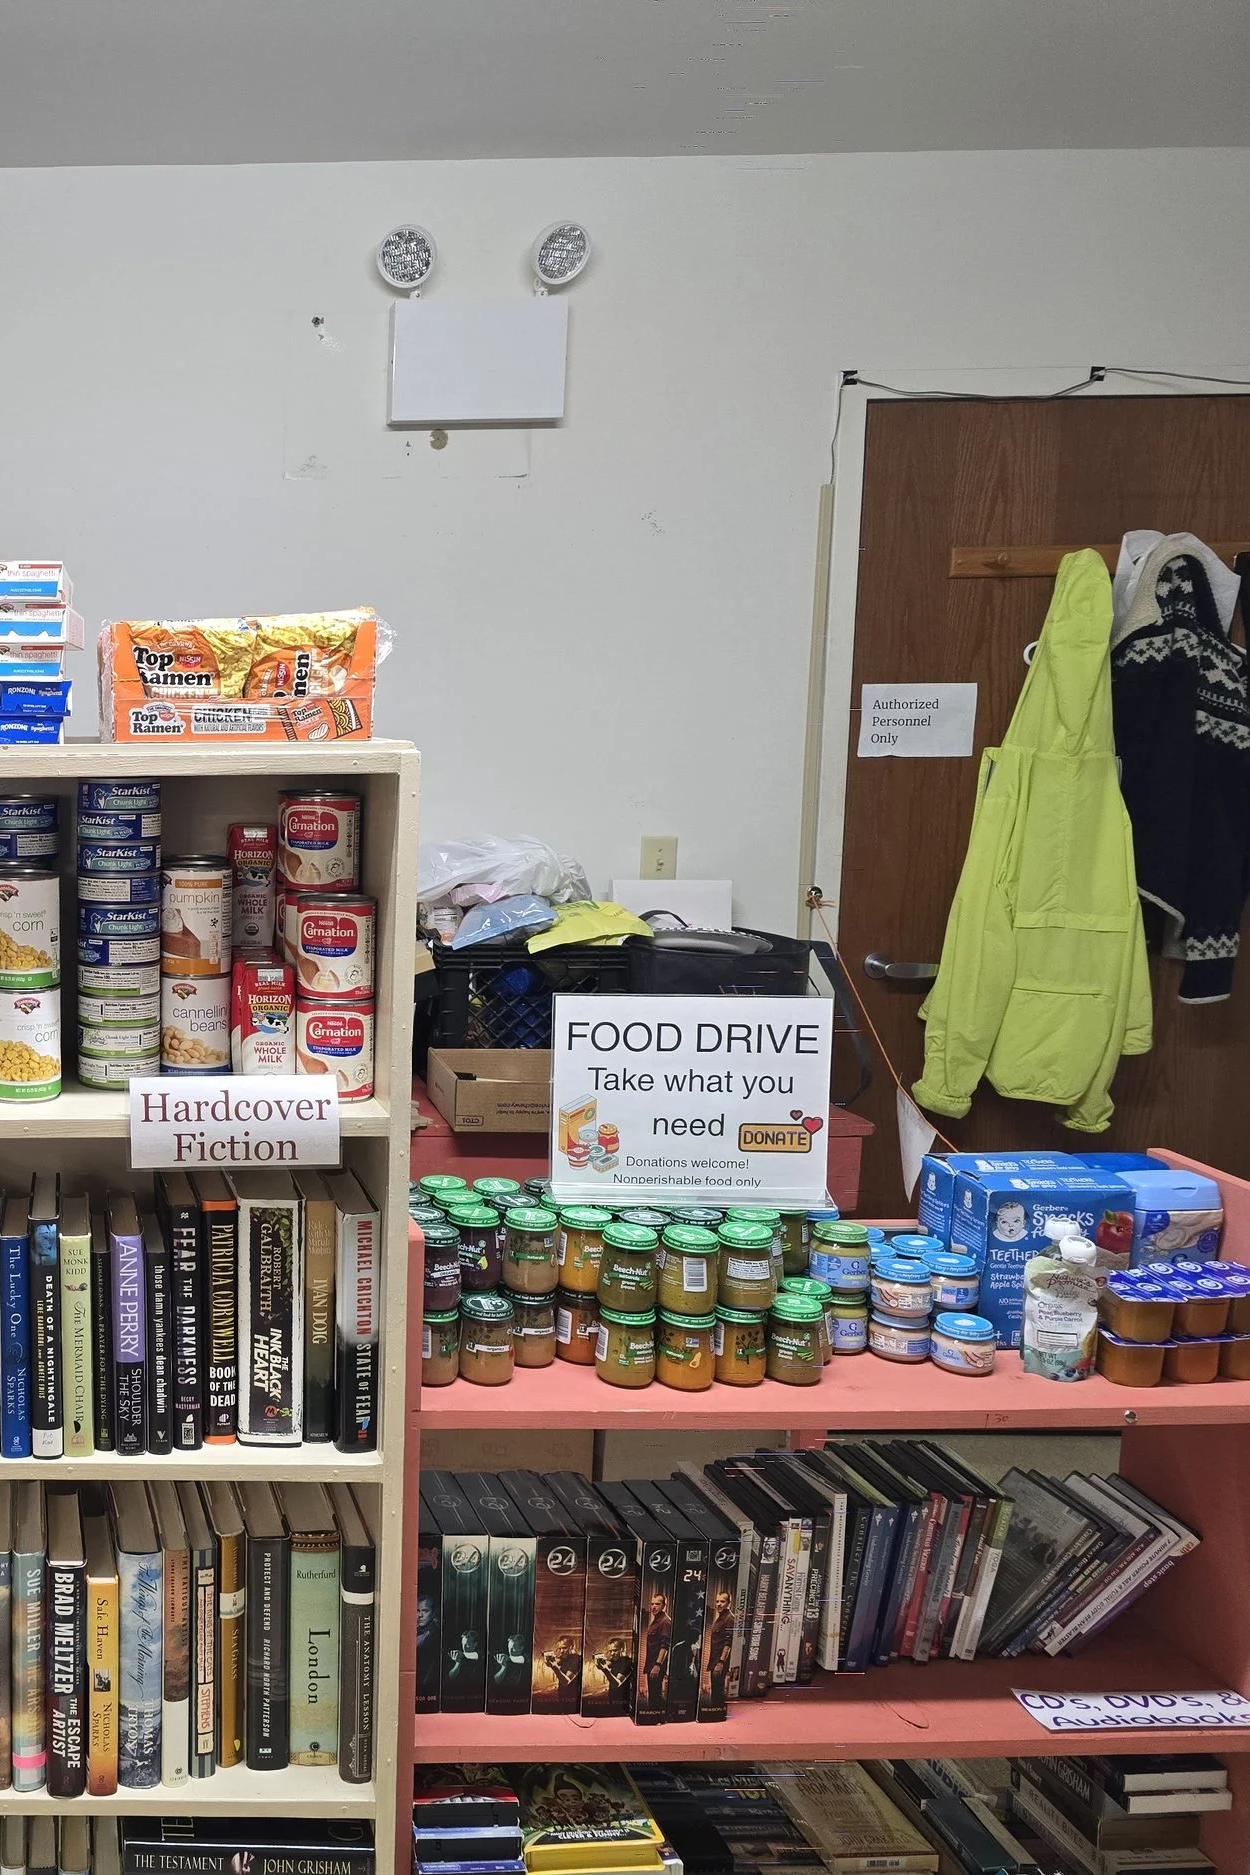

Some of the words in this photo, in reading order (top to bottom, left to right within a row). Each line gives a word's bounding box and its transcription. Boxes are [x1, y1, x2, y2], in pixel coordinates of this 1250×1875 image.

[7, 569, 20, 577] thin
[22, 569, 55, 579] spaghetti
[133, 647, 173, 667] Top
[872, 699, 939, 709] Authorized
[132, 712, 158, 722] Top
[194, 709, 250, 721] CHICKEN
[872, 716, 931, 726] Personnel
[133, 722, 180, 733] Ramen
[871, 734, 898, 745] Only
[111, 787, 150, 796] StarKist
[2, 807, 40, 816] StarKist
[289, 819, 335, 832] Carnation
[169, 892, 219, 905] pumpkin
[13, 919, 43, 931] corn
[304, 924, 353, 938] Carnation
[248, 994, 292, 1004] HORIZON
[567, 1022, 682, 1052] FOOD
[696, 1024, 819, 1054] DRIVE
[253, 1047, 286, 1056] WHOLE
[258, 1055, 283, 1063] MILK
[588, 1068, 654, 1091] Take
[664, 1069, 733, 1093] what
[743, 1075, 793, 1099] you
[140, 1090, 331, 1123] Hardcover
[653, 1114, 725, 1136] need
[743, 1130, 807, 1146] DONATE
[173, 1132, 299, 1161] Fiction
[626, 1157, 687, 1168] Donations
[691, 1157, 749, 1169] welcome!
[613, 1174, 701, 1185] Nonperishable
[705, 1176, 733, 1186] food
[735, 1177, 761, 1189] only
[1033, 1204, 1064, 1213] Gerber
[357, 1221, 372, 1273] MICHAEL
[9, 1246, 20, 1270] The
[212, 1225, 234, 1286] PATRICIA
[119, 1244, 138, 1297] ANNE
[10, 1274, 21, 1309] Lucky
[357, 1278, 371, 1335] CRICHTON
[10, 1314, 21, 1337] One
[121, 1302, 139, 1356] PERRY
[213, 1291, 234, 1363] CORNWELL
[210, 1367, 237, 1378] BOOK
[221, 1381, 235, 1390] THE
[210, 1396, 236, 1406] DEAD
[550, 1552, 575, 1567] 24
[600, 1556, 625, 1572] 24
[297, 1570, 336, 1579] Rutherfurd
[55, 1573, 73, 1616] BRAD
[97, 1598, 108, 1620] Safe
[97, 1624, 108, 1659] Haven
[54, 1624, 73, 1694] MELTZER
[308, 1628, 330, 1704] London
[1217, 1691, 1249, 1707] &
[135, 1855, 155, 1869] THE
[159, 1855, 224, 1870] TESTAMENT
[262, 1858, 295, 1875] JOHN
[297, 1860, 352, 1875] GRISHAM
